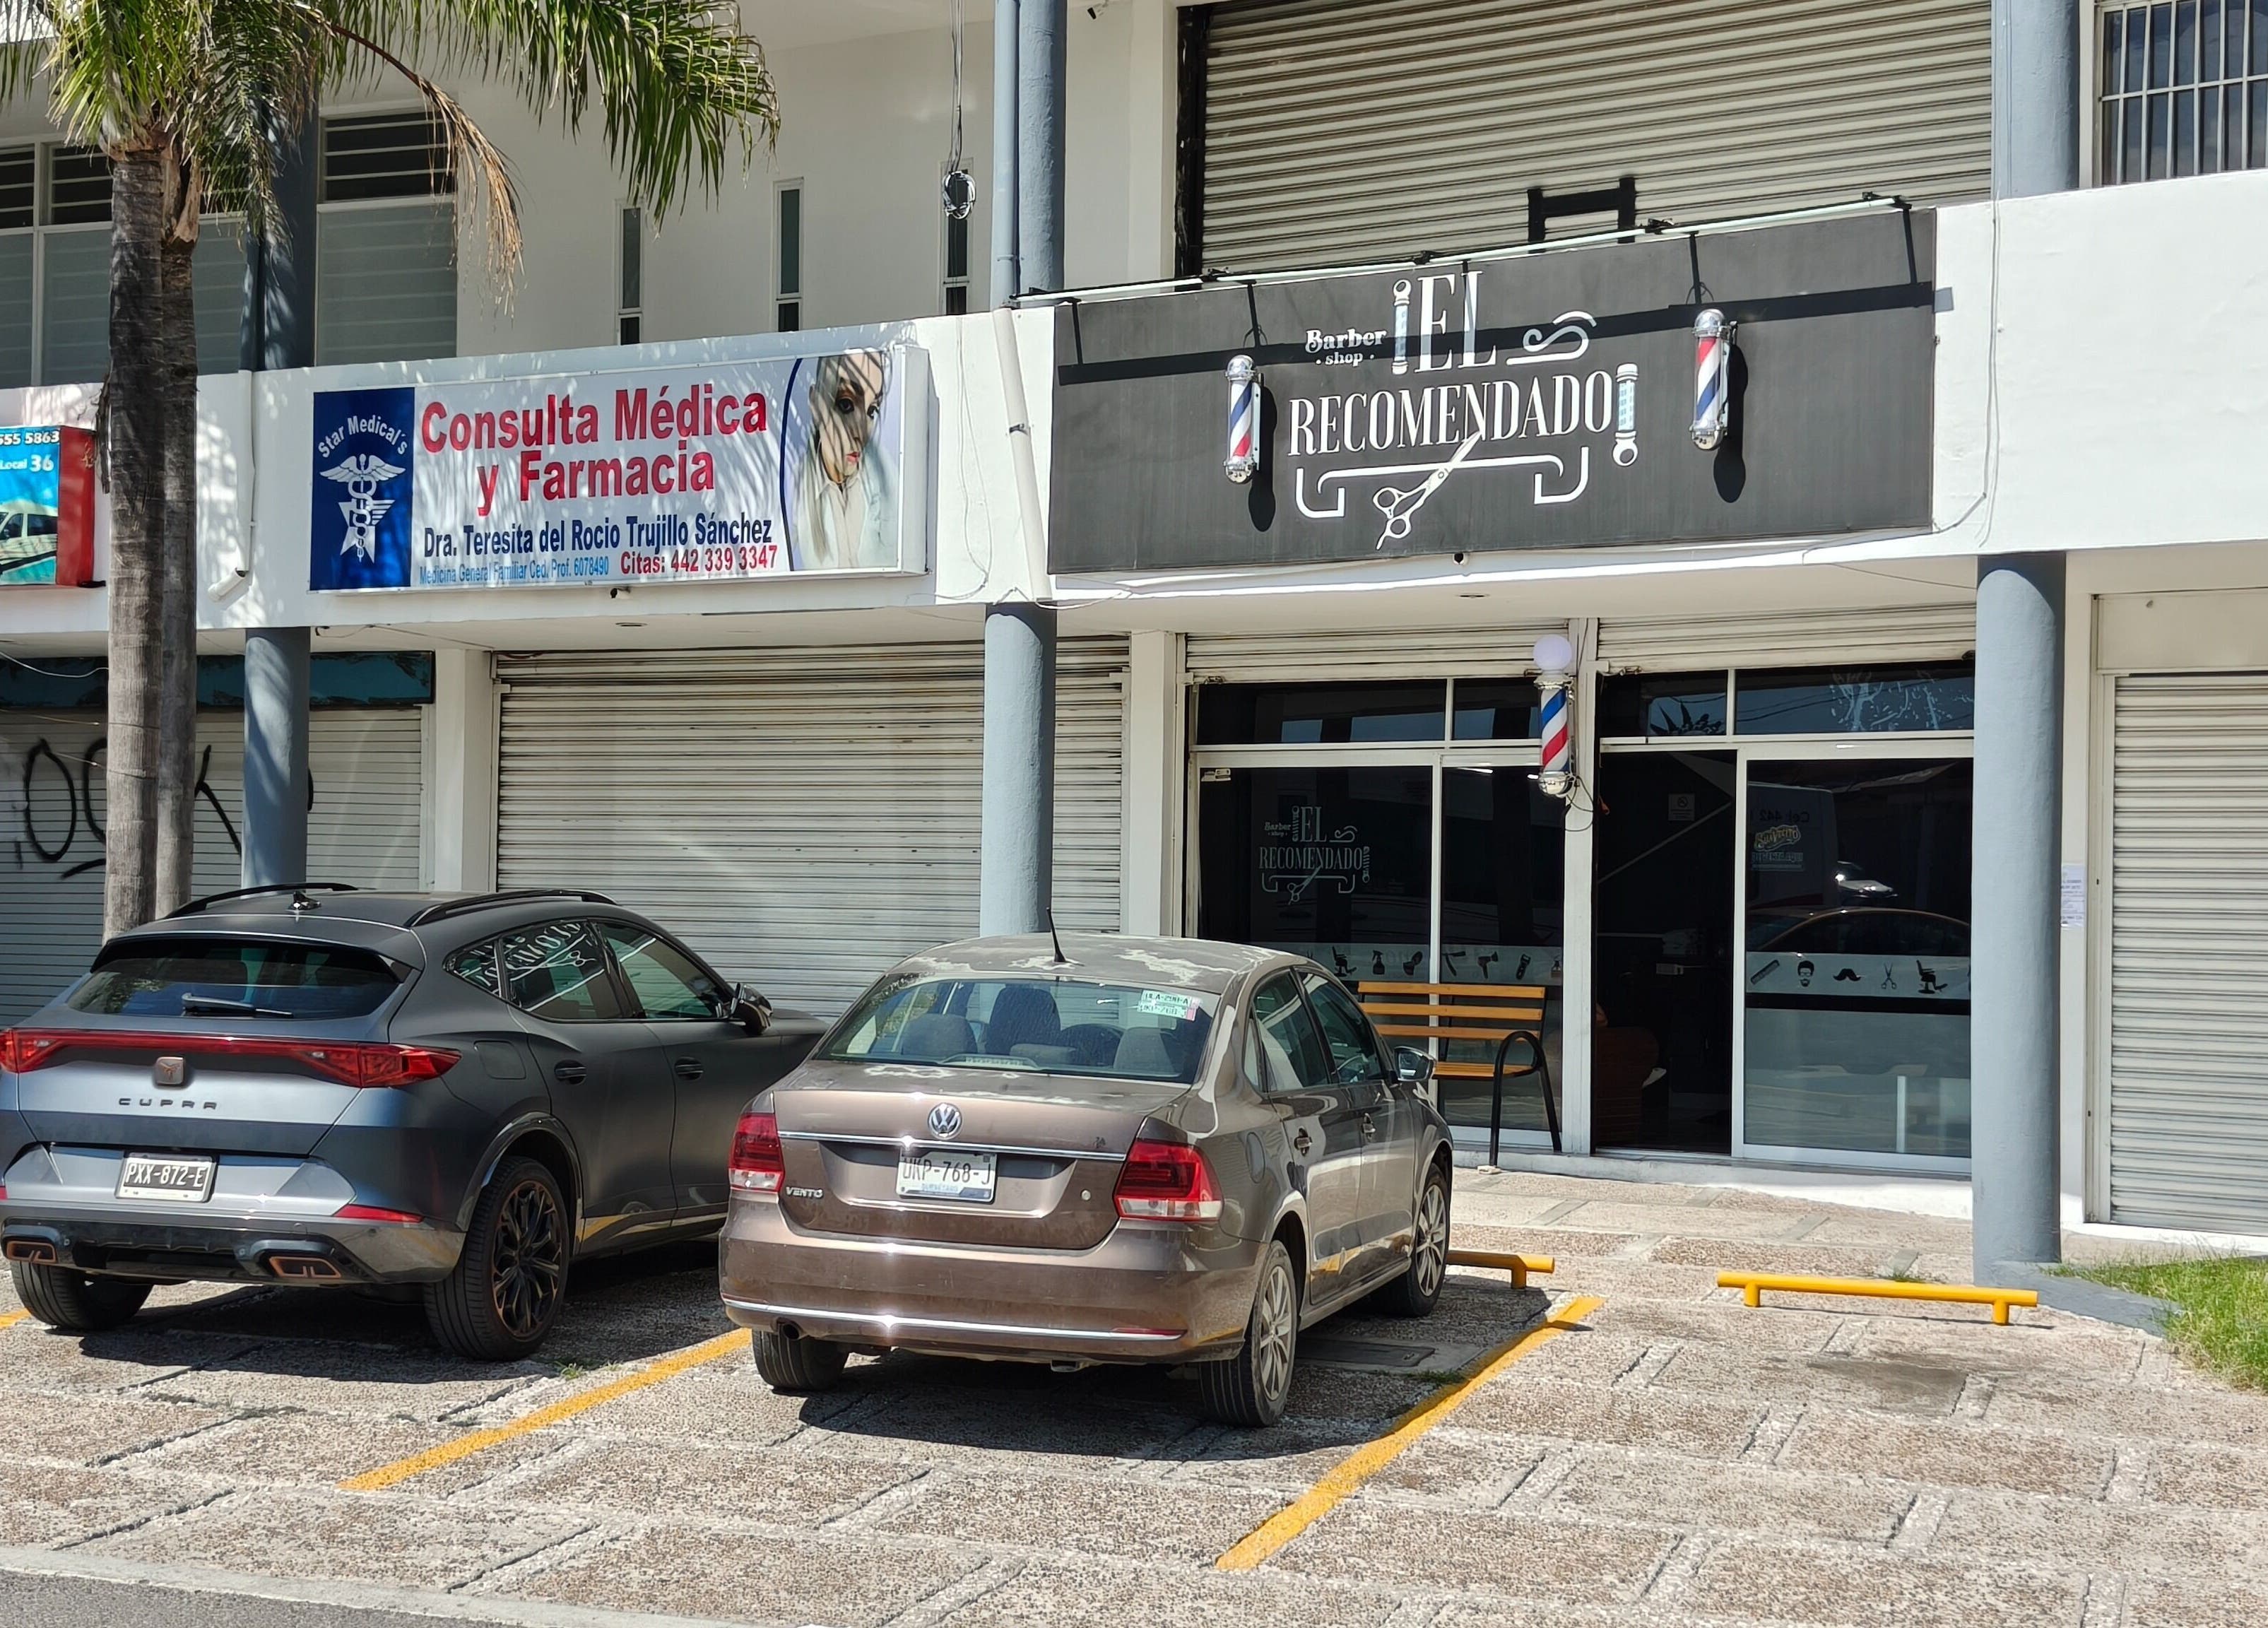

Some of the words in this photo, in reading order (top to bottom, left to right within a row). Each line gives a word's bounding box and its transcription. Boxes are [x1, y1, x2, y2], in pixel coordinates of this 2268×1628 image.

[1305, 328, 1387, 353] Barber
[1325, 351, 1364, 367] shop
[421, 393, 599, 454] Consulta
[615, 382, 767, 441] Médica
[1287, 370, 1612, 457] RECOMENDADO
[25, 430, 60, 444] 5863
[318, 425, 345, 458] Star
[0, 458, 28, 470] Local
[30, 454, 54, 472] 36
[477, 464, 499, 517] y
[520, 440, 715, 502] Farmacia
[424, 526, 457, 558] Dra.
[463, 521, 534, 555] Teresita
[539, 519, 565, 552] del
[572, 517, 620, 551] Rocio
[626, 514, 689, 554] Trujillo
[695, 512, 772, 545] Sánchez
[420, 565, 456, 585] Medicina
[459, 563, 491, 583] General
[494, 561, 527, 582] Familiar
[529, 560, 549, 579] Ced.
[551, 558, 572, 577] Prof.
[574, 556, 609, 577] 6078490
[620, 550, 666, 574] Citas:
[671, 548, 699, 572] 442
[704, 546, 733, 572] 339
[738, 545, 778, 570] 3347
[1300, 806, 1327, 842] EL
[1259, 846, 1362, 871] RECOMENDADO
[118, 1097, 217, 1110] CUPRA
[125, 1162, 208, 1188] PXX-872-E
[902, 1157, 991, 1185] UKP-768-J
[786, 1186, 823, 1198] VENTO
